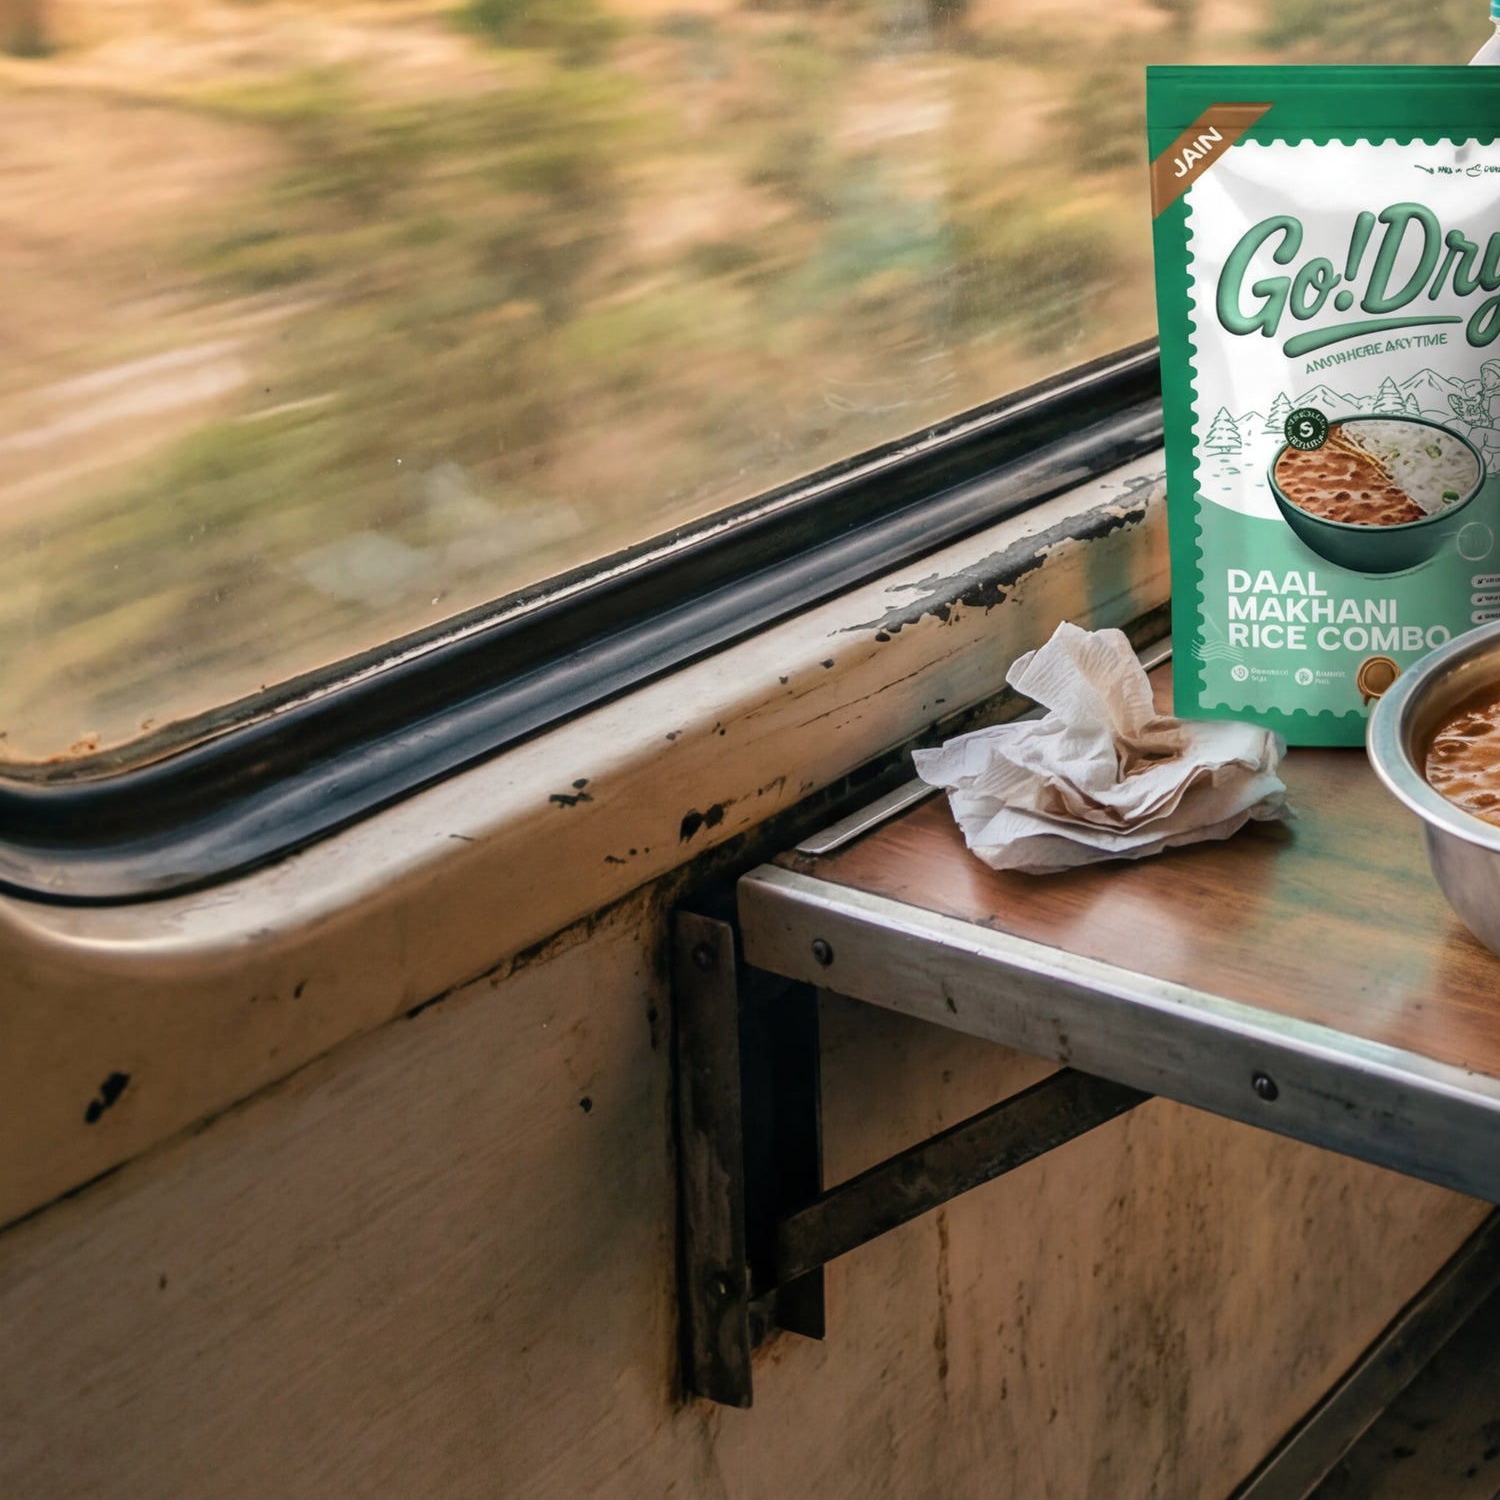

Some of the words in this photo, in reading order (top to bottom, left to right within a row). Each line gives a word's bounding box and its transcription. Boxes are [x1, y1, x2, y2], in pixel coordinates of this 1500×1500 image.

[1173, 126, 1223, 178] JAIN
[1227, 569, 1328, 596] DAAL
[1228, 596, 1397, 624] MAKHANI
[1228, 623, 1307, 650] RICE
[1317, 625, 1451, 651] COMBO
